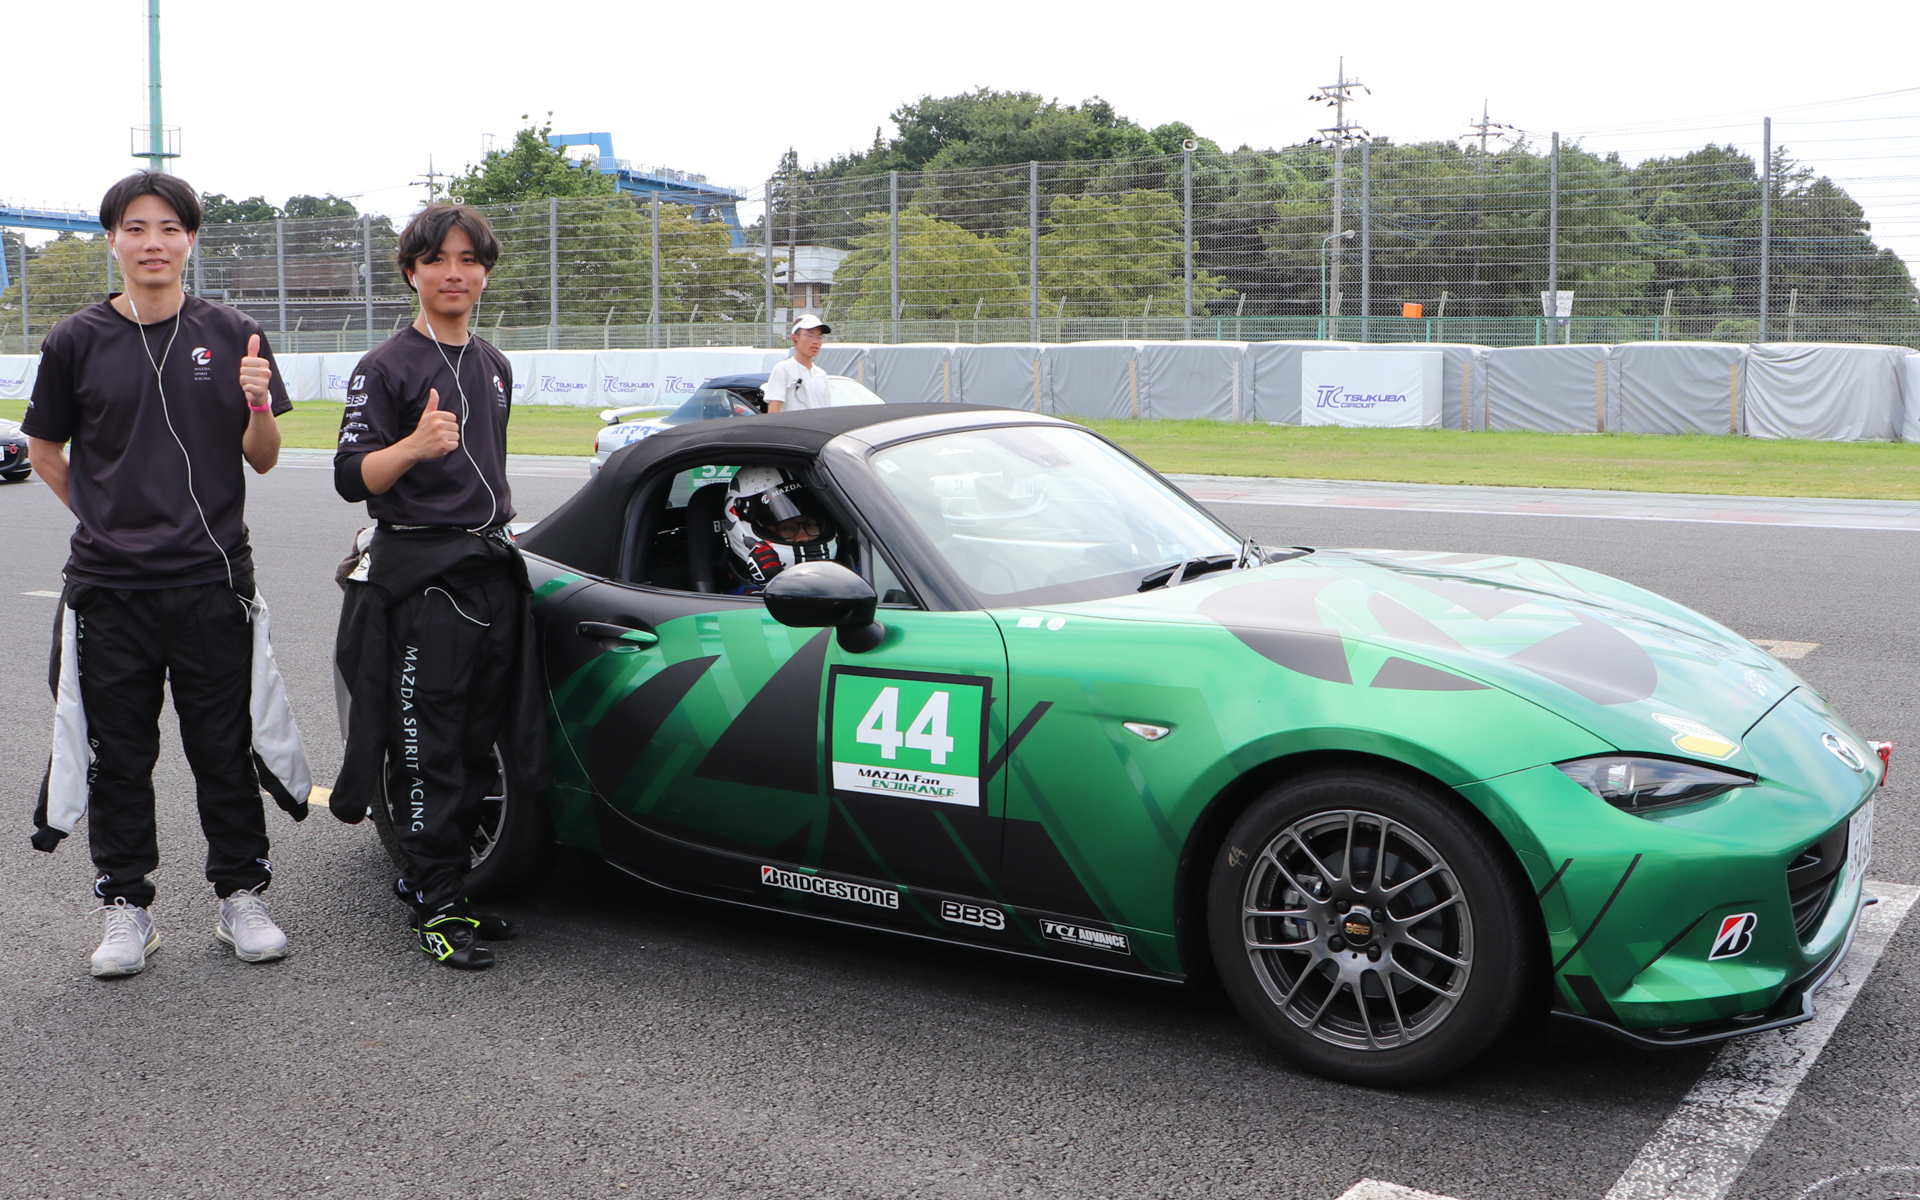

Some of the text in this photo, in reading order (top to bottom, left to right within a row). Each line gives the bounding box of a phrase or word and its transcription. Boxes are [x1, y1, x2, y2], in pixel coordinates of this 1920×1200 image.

[1343, 394, 1406, 402] TSUKUBA
[772, 484, 802, 498] MAZDA
[856, 686, 954, 765] 44
[401, 645, 424, 832] MAZDA SPIRIT ACING
[858, 768, 940, 785] MAZDA Fan
[872, 779, 955, 797] ENDURANCE
[1228, 846, 1248, 867] 44
[761, 865, 899, 910] BRIDGESTONE
[941, 900, 1006, 931] BBS
[1044, 922, 1077, 939] TCL
[1078, 928, 1127, 949] ADVANCE
